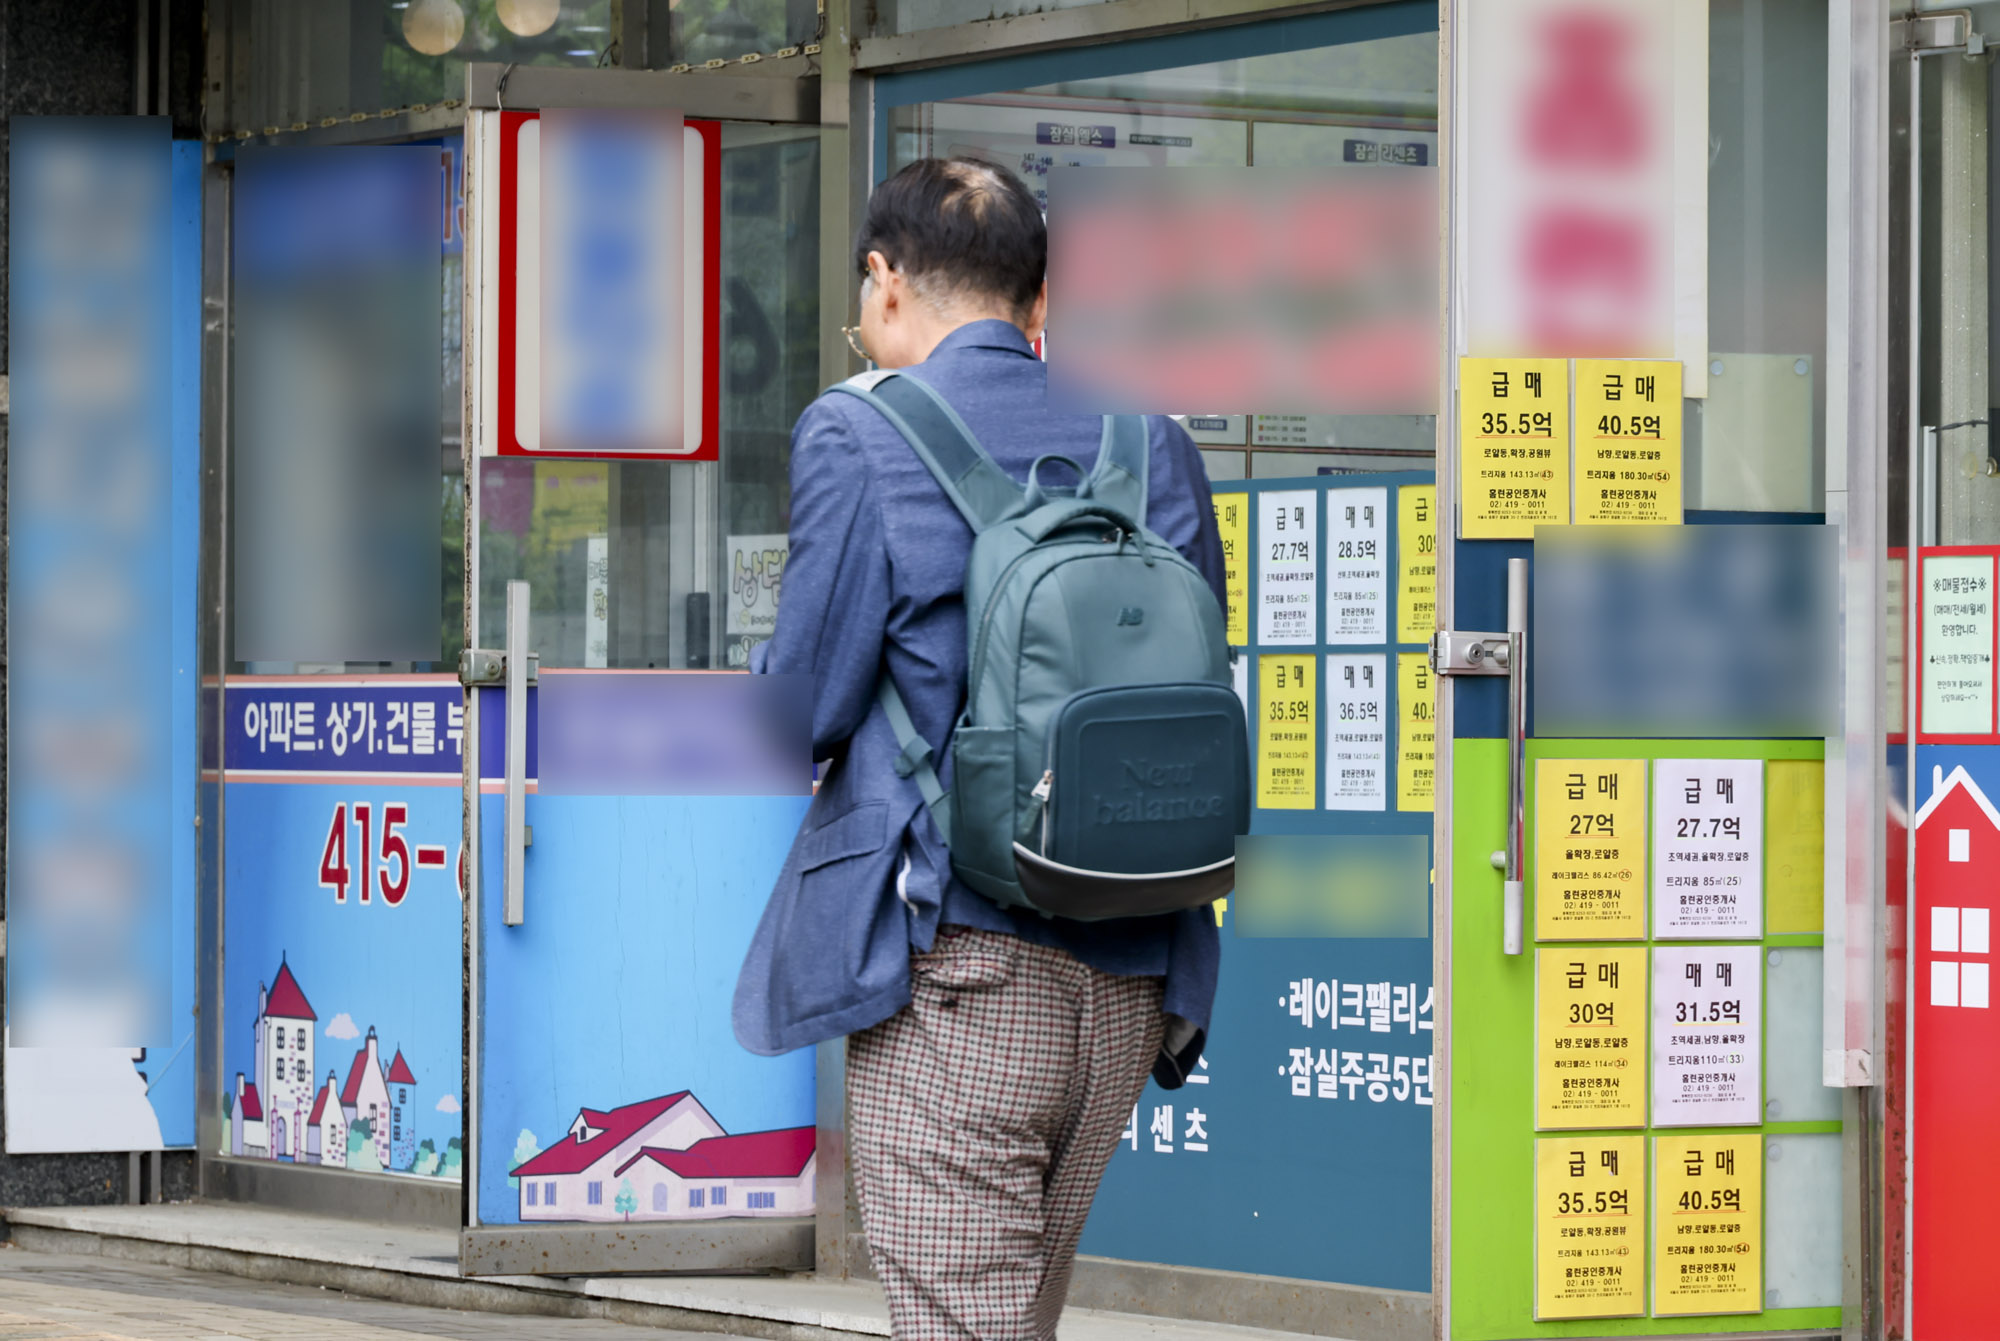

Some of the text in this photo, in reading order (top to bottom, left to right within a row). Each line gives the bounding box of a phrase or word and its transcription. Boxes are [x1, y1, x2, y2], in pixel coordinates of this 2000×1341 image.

[1049, 126, 1074, 144] 잠실
[1482, 412, 1551, 437] 35.5억
[1598, 415, 1660, 439] 40.5억
[1272, 541, 1308, 561] 27.7억
[1339, 540, 1375, 559] 28.5억
[1270, 701, 1308, 722] 35.5억
[1340, 702, 1377, 721] 36.5억
[1122, 759, 1196, 791] New
[1093, 792, 1223, 825] balance
[1570, 814, 1614, 836] 27억
[1677, 817, 1740, 840] 27.7억
[318, 801, 463, 908] 415-
[1570, 1002, 1613, 1025] 30억
[1676, 1000, 1740, 1023] 31.5억
[1559, 1189, 1628, 1214] 35.5억
[1679, 1189, 1740, 1211] 40.5억
